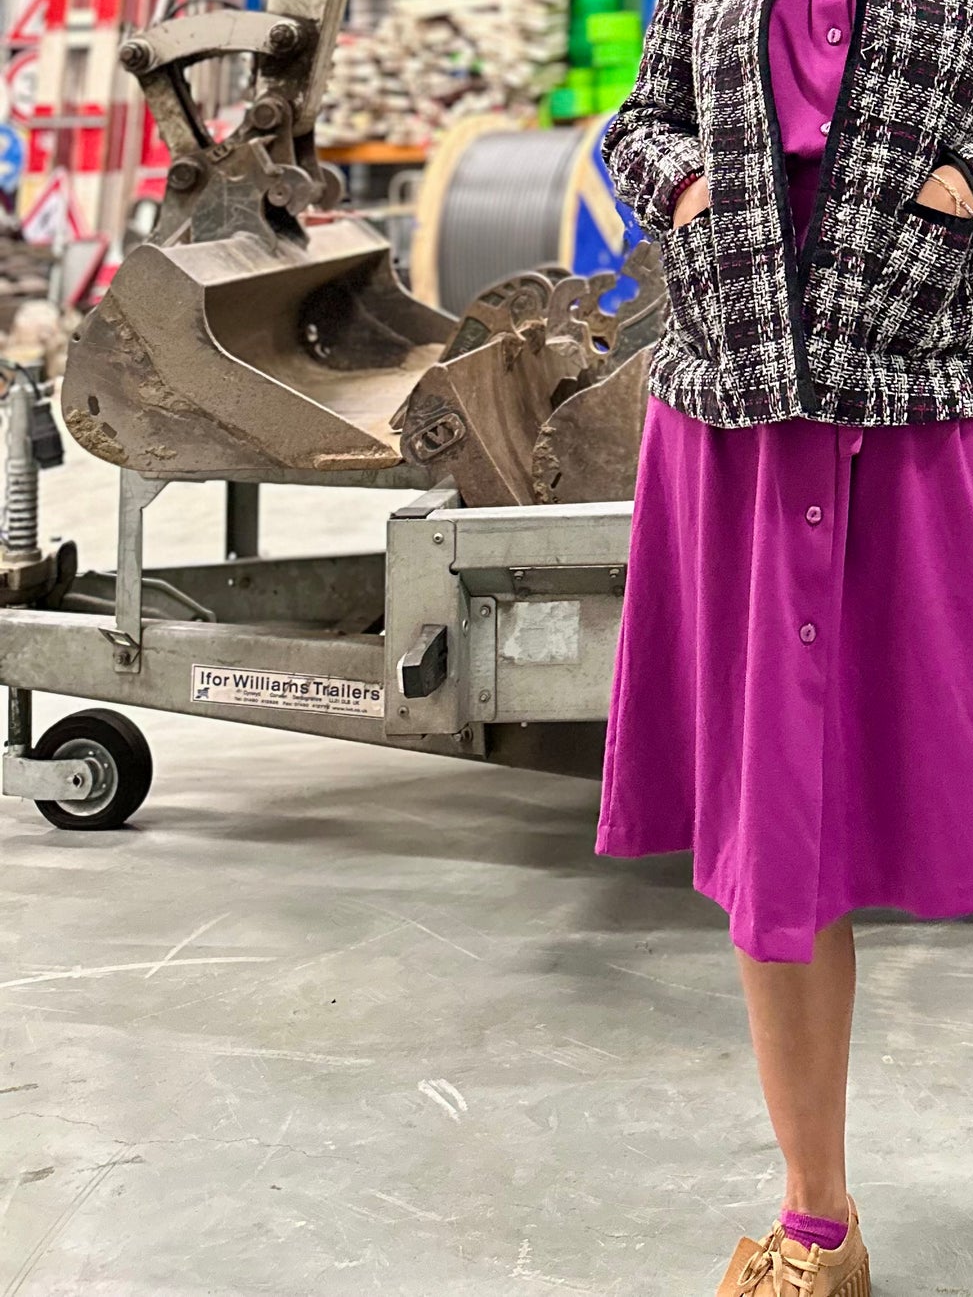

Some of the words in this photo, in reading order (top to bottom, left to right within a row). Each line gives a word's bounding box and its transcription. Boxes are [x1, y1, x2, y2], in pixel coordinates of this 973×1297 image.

[201, 671, 230, 687] Ifor
[233, 674, 309, 694] Williams
[313, 681, 380, 701] Trailers
